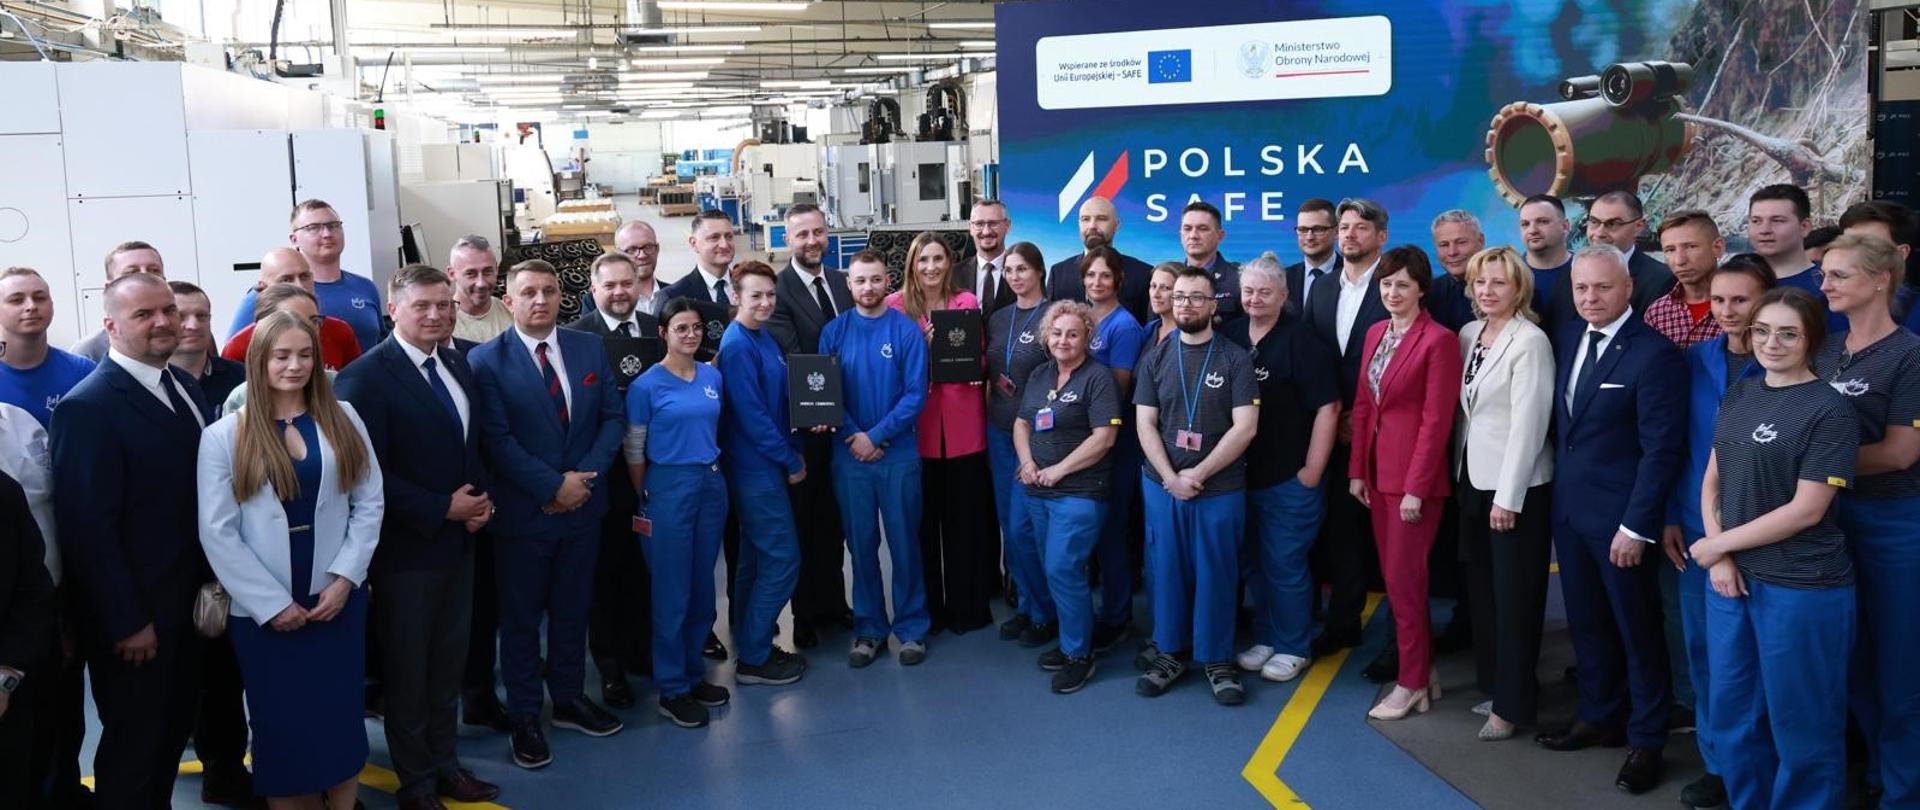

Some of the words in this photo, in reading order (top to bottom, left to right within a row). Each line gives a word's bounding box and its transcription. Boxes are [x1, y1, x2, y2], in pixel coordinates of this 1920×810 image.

[1274, 41, 1341, 53] Ministerstwo
[1058, 61, 1098, 71] Wspierane
[1099, 61, 1108, 69] ze
[1109, 58, 1142, 68] środków
[1275, 55, 1313, 67] Obrony
[1314, 52, 1371, 64] Narodowej
[1053, 72, 1069, 82] Unii
[1069, 70, 1115, 81] Europejskiej
[1122, 69, 1142, 79] SAFE
[1144, 143, 1370, 178] POLSKA
